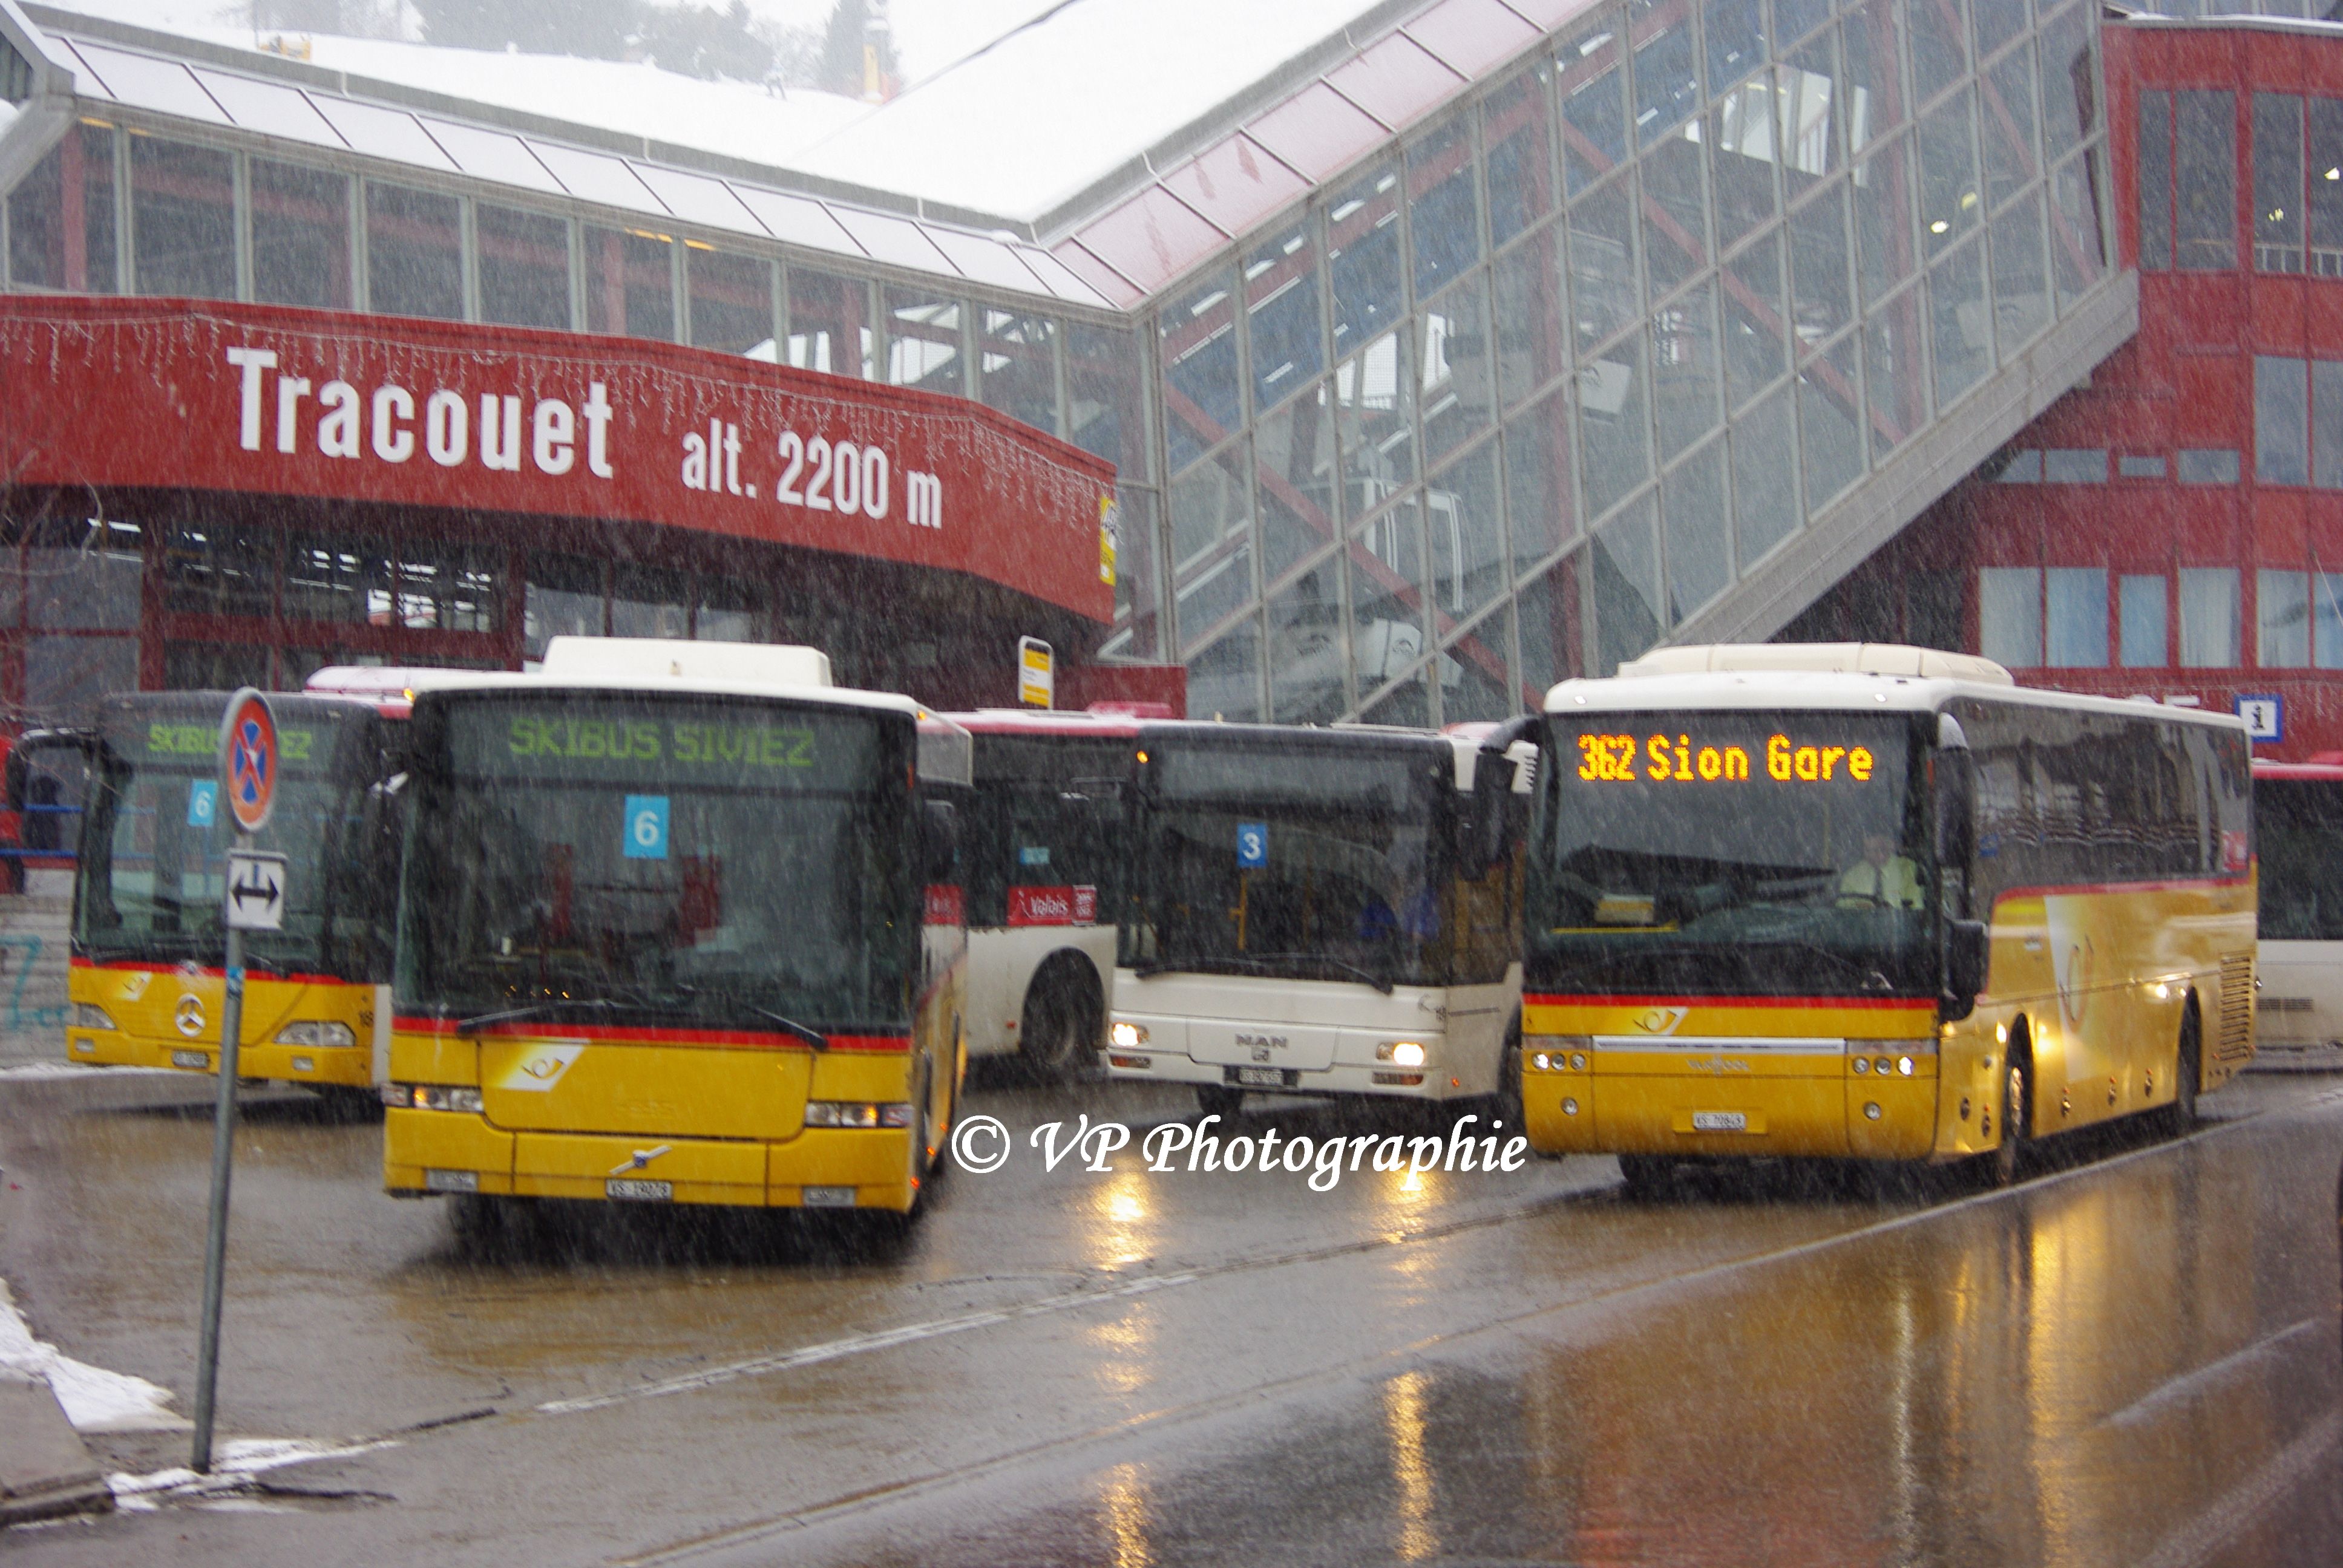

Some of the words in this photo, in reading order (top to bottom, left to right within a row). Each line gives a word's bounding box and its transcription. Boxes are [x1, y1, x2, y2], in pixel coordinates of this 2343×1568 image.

[227, 347, 614, 480] Tracouet
[681, 417, 757, 499] alt.
[776, 430, 889, 520] 2200
[908, 470, 942, 529] m
[509, 719, 661, 760] SKIBUS
[673, 728, 814, 768] SIVIEZ
[1578, 734, 1637, 782] 362
[1647, 733, 1749, 782] Sion
[1766, 733, 1874, 782] Gare
[194, 790, 211, 818] 6
[634, 811, 659, 846] 6
[1243, 832, 1261, 860] 3
[1235, 1034, 1288, 1049] MAN
